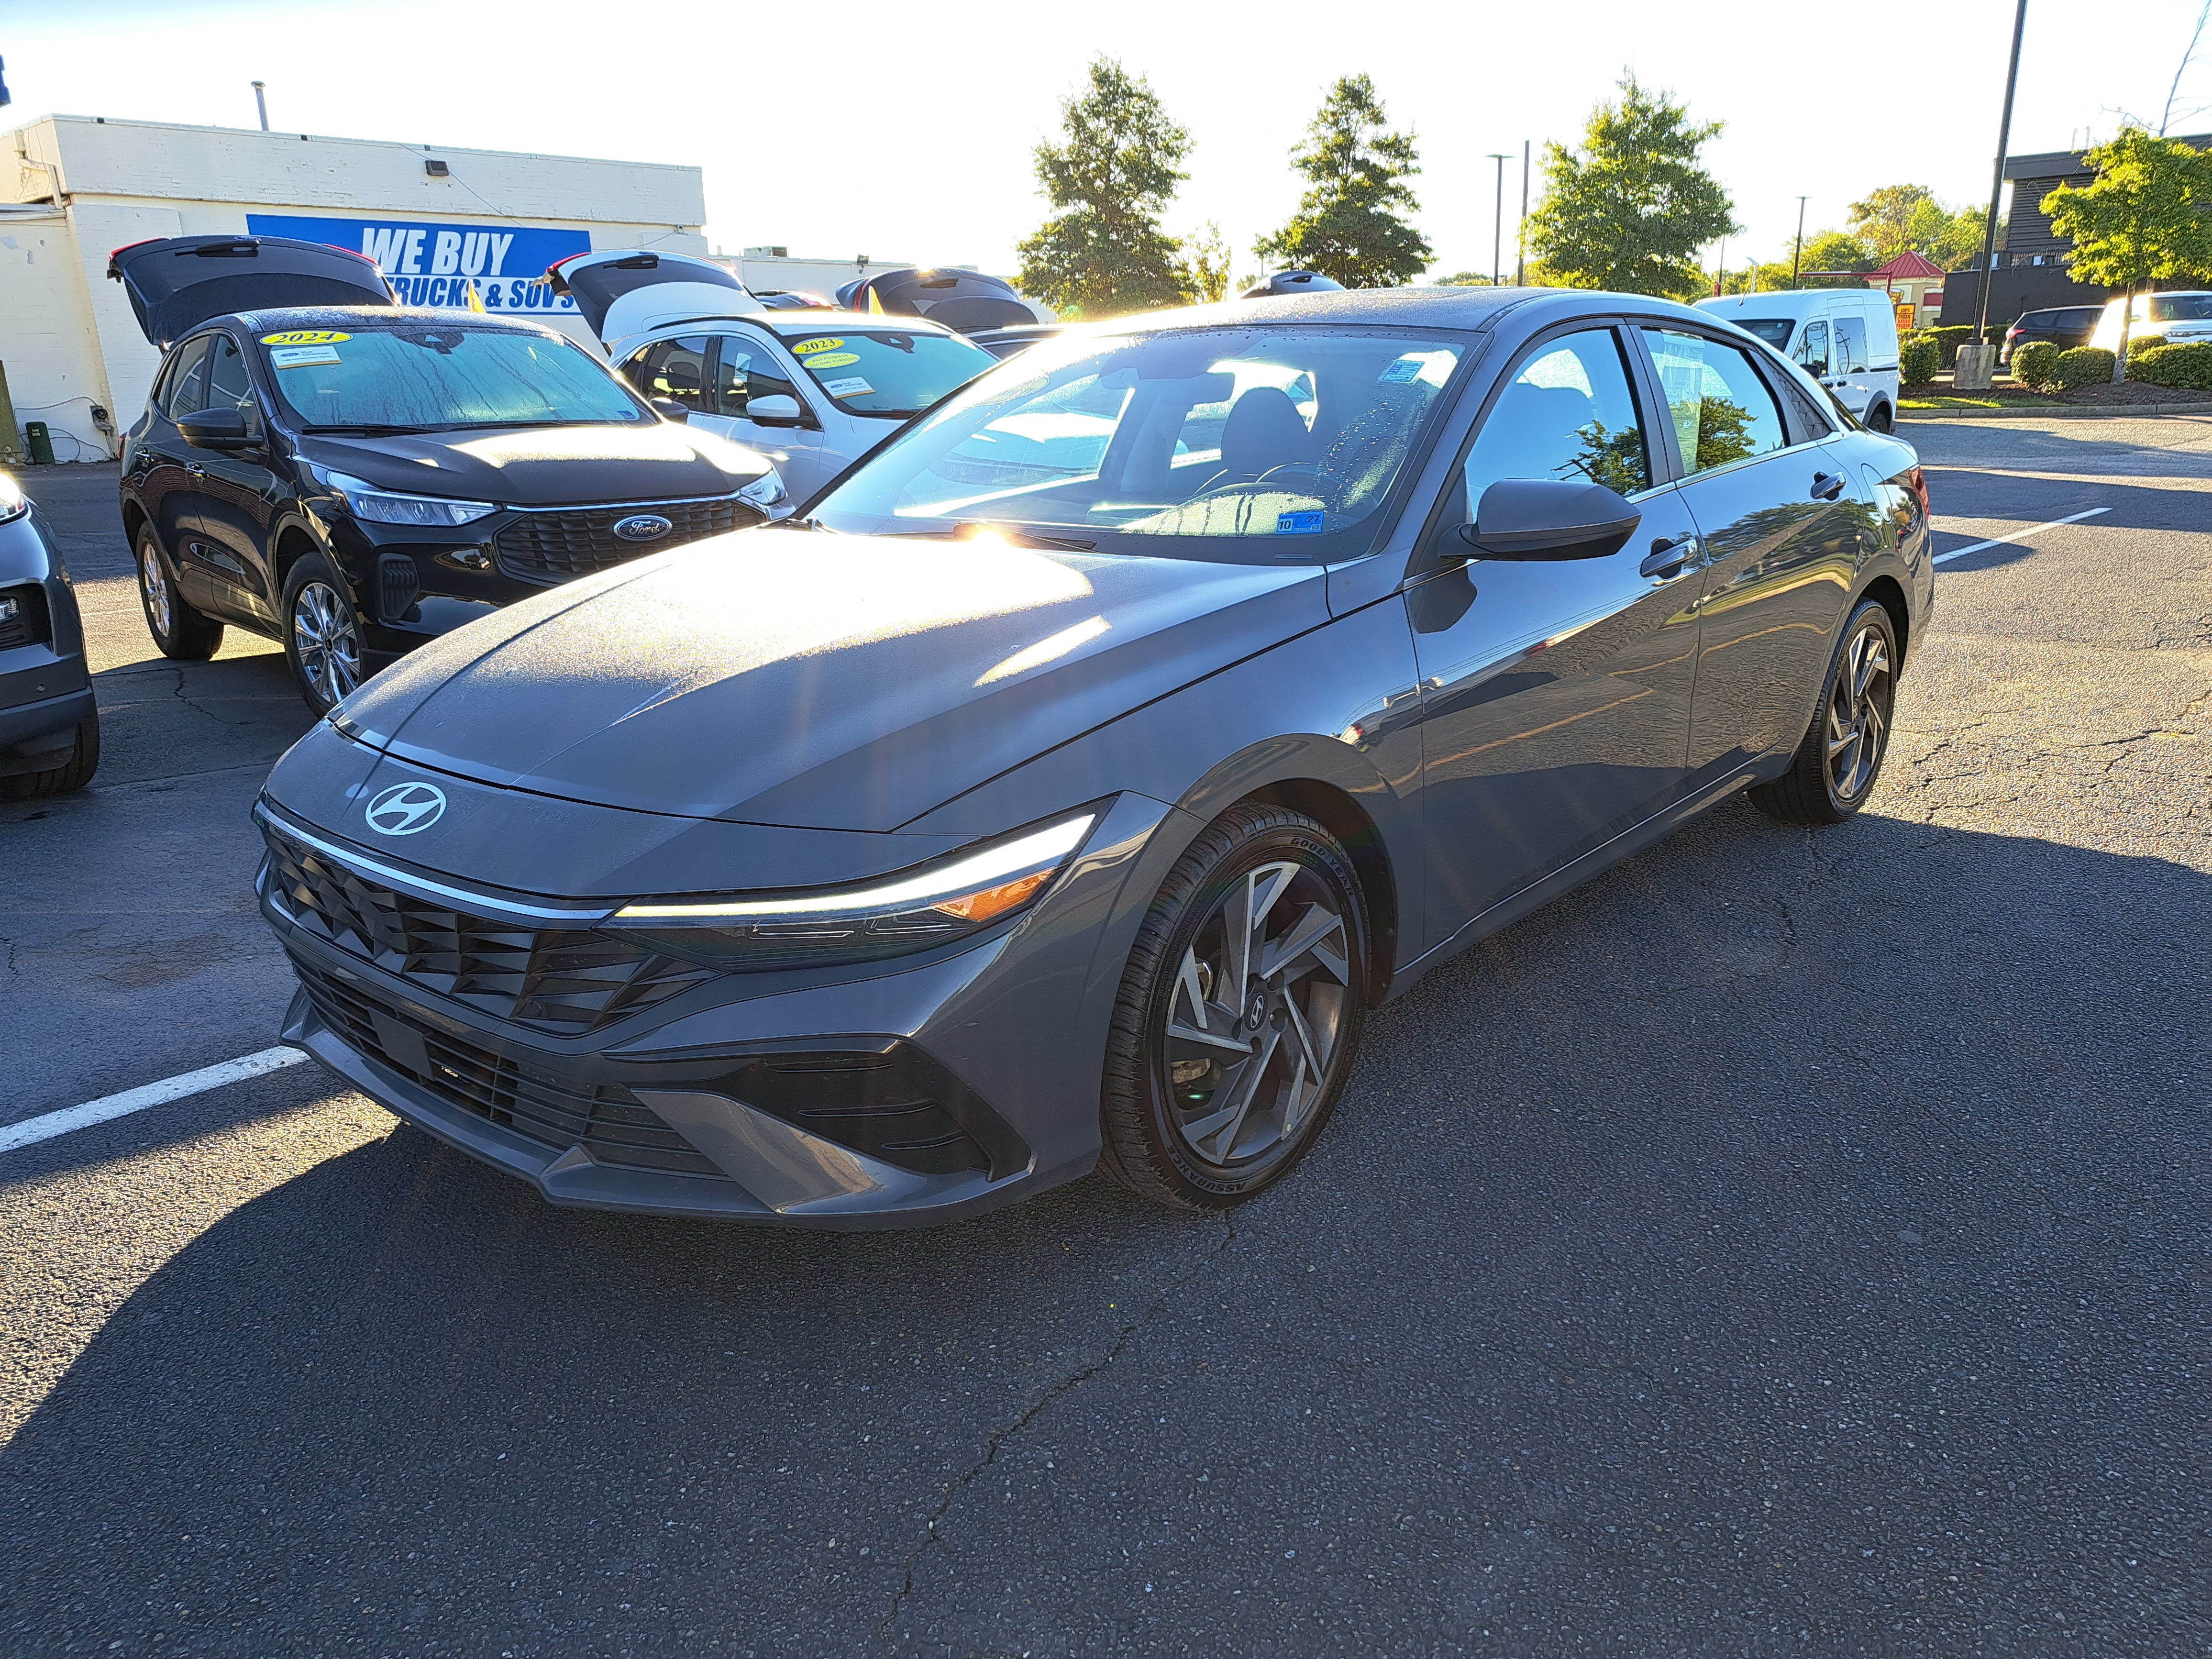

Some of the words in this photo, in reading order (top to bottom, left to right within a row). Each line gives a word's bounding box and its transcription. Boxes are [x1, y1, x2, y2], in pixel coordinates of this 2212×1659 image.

[362, 227, 427, 274] WE
[431, 231, 514, 276] BUY
[386, 277, 481, 307] RUCKS
[485, 284, 503, 308] &
[273, 332, 336, 343] 2024
[802, 339, 836, 353] 2023
[1279, 520, 1291, 530] 10
[1307, 515, 1320, 523] 27
[629, 520, 660, 535] Ford
[1290, 837, 1354, 896] GOODYEAR
[1166, 1144, 1247, 1193] ASSURANCE
